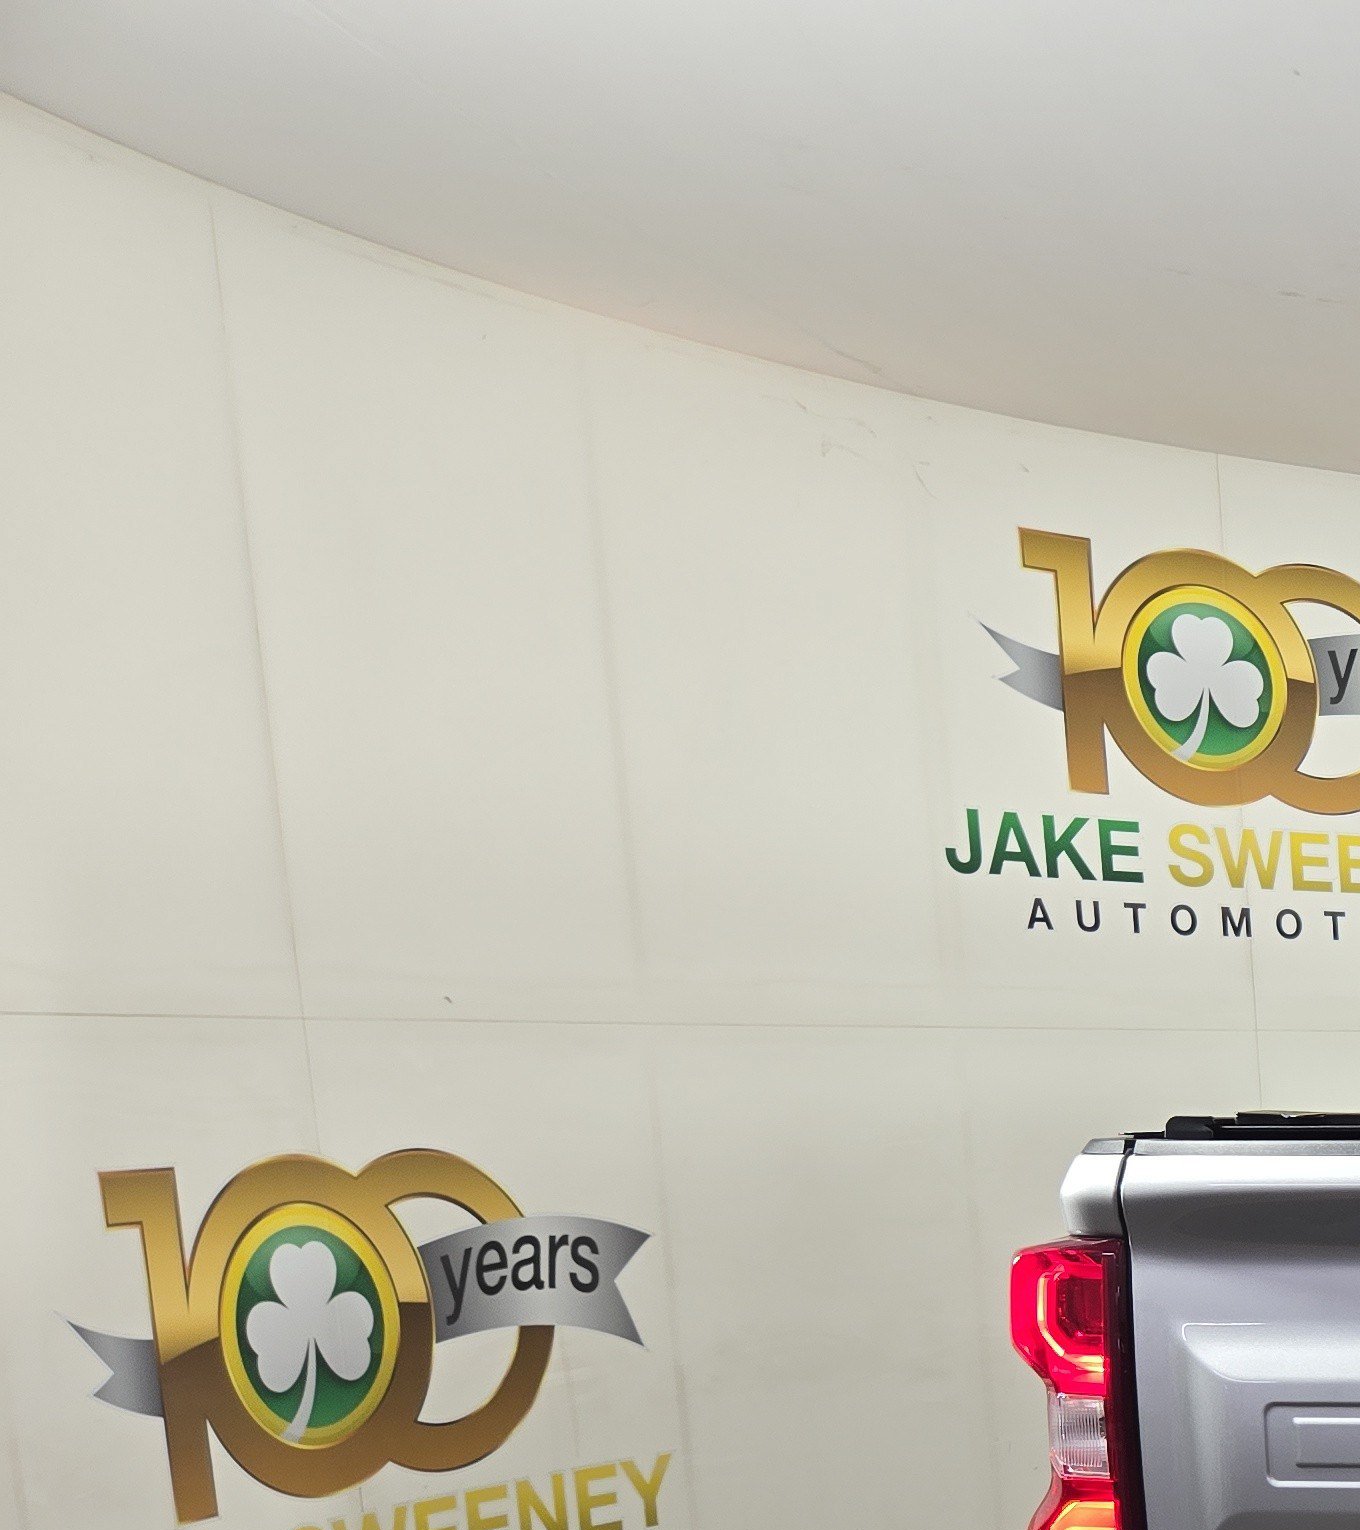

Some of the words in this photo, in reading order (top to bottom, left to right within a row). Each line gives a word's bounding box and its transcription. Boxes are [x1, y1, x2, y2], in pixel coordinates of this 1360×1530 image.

[945, 808, 1145, 884] JAKE
[439, 1231, 601, 1325] years
[98, 1147, 556, 1526] 100
